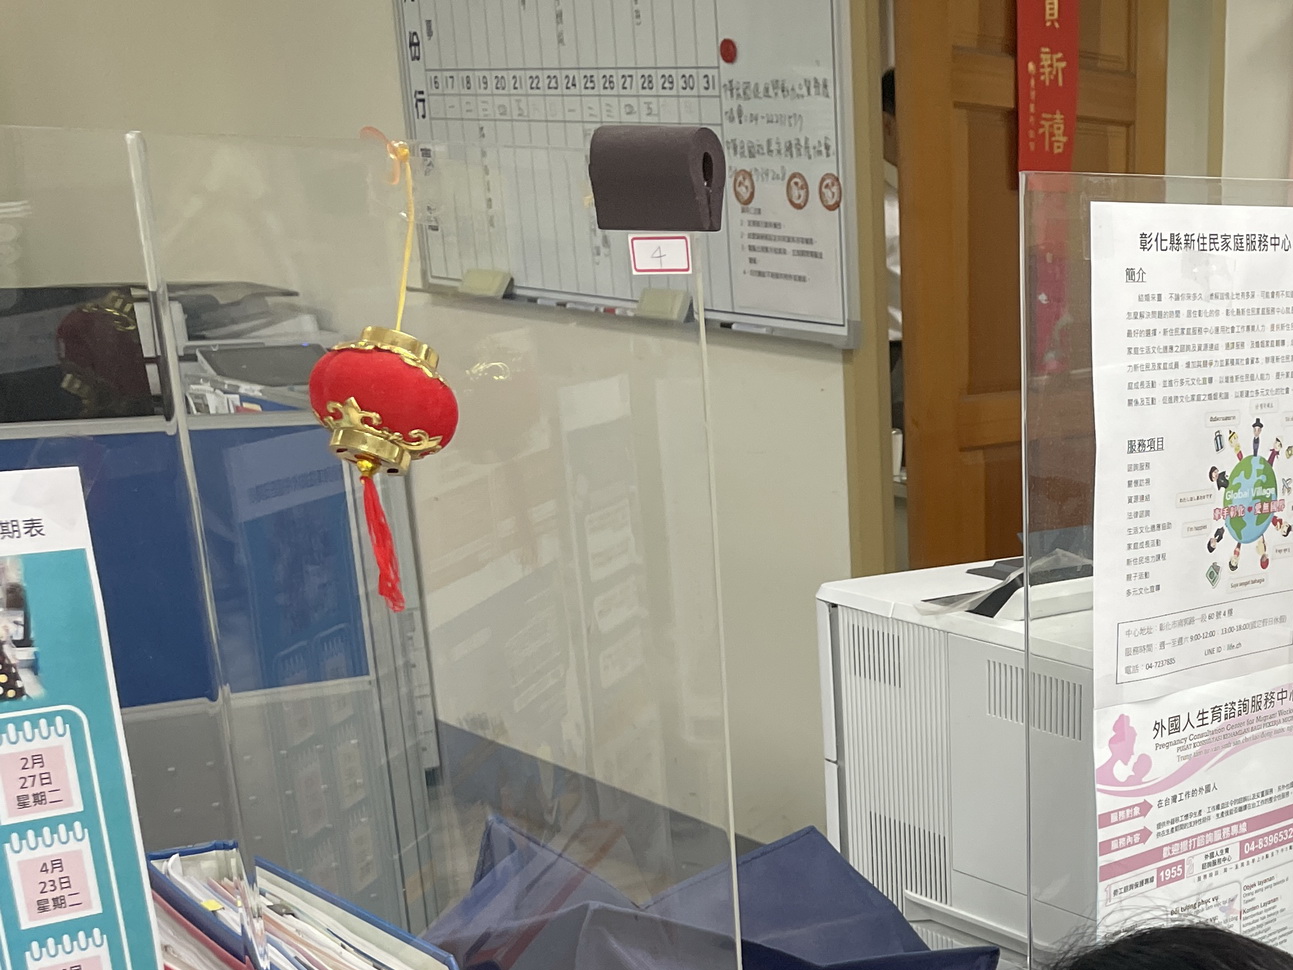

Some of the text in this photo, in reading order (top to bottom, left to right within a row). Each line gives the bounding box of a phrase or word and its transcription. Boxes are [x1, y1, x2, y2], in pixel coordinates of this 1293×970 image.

[429, 75, 439, 90] 16
[444, 75, 454, 90] 17
[461, 75, 471, 90] 18
[478, 75, 488, 90] 19
[494, 75, 506, 90] 20
[512, 75, 523, 90] 21
[529, 75, 541, 90] 22
[547, 75, 558, 90] 23
[565, 75, 577, 90] 24
[583, 75, 596, 90] 25
[602, 75, 615, 90] 26
[621, 75, 634, 90] 27
[640, 75, 654, 90] 28
[660, 75, 674, 90] 29
[681, 75, 695, 90] 30
[703, 75, 716, 90] 31
[1139, 231, 1292, 253] 彰化縣新住民家庭服務中心
[651, 246, 667, 270] 4
[1125, 267, 1147, 283] 簡介
[1127, 437, 1164, 454] 服務項目
[1225, 489, 1249, 501] Global
[1251, 487, 1276, 499] Village
[1155, 737, 1187, 751] Pregnancy
[1226, 720, 1246, 731] Center
[20, 753, 46, 770] 2月
[19, 772, 52, 790] 27日
[16, 788, 63, 810] 星期二
[1157, 782, 1218, 809] 在台灣工作的外國人
[1110, 806, 1141, 824] 服務對象
[1111, 833, 1141, 851] 服務內容
[39, 858, 65, 874] 4月
[1160, 865, 1183, 882] 1955
[39, 876, 72, 893] 23日
[36, 892, 83, 914] 星期二
